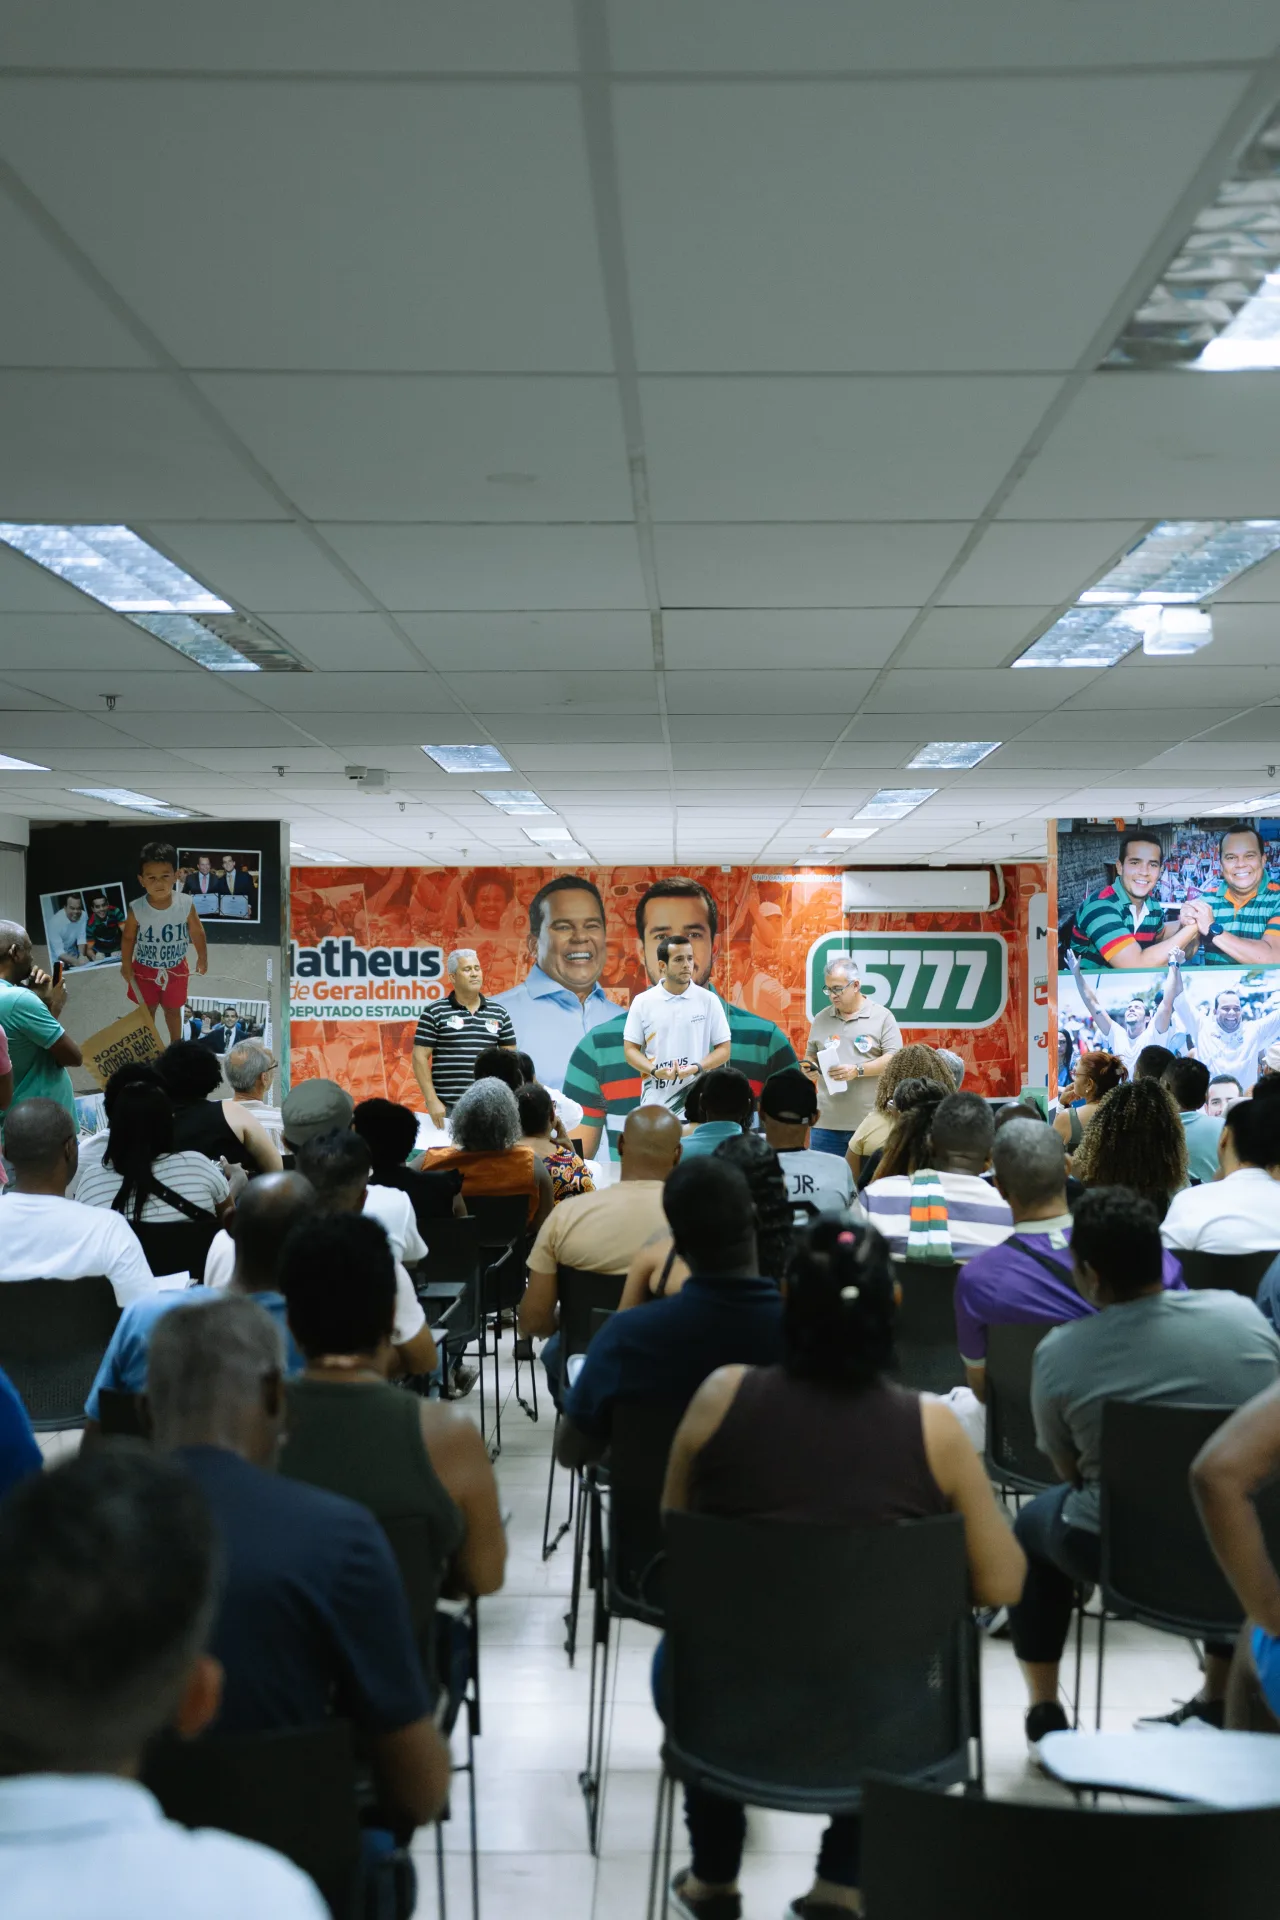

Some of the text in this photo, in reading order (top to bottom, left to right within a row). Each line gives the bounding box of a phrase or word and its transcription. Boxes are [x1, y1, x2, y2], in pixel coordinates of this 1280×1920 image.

[312, 978, 441, 1000] Geraldinho
[826, 949, 988, 1010] 5777
[366, 1005, 425, 1018] ESTADU
[92, 1025, 151, 1063] VEREADOR
[131, 1032, 157, 1058] SUPER
[655, 1056, 689, 1070] ATHUS
[792, 1174, 820, 1195] JR.
